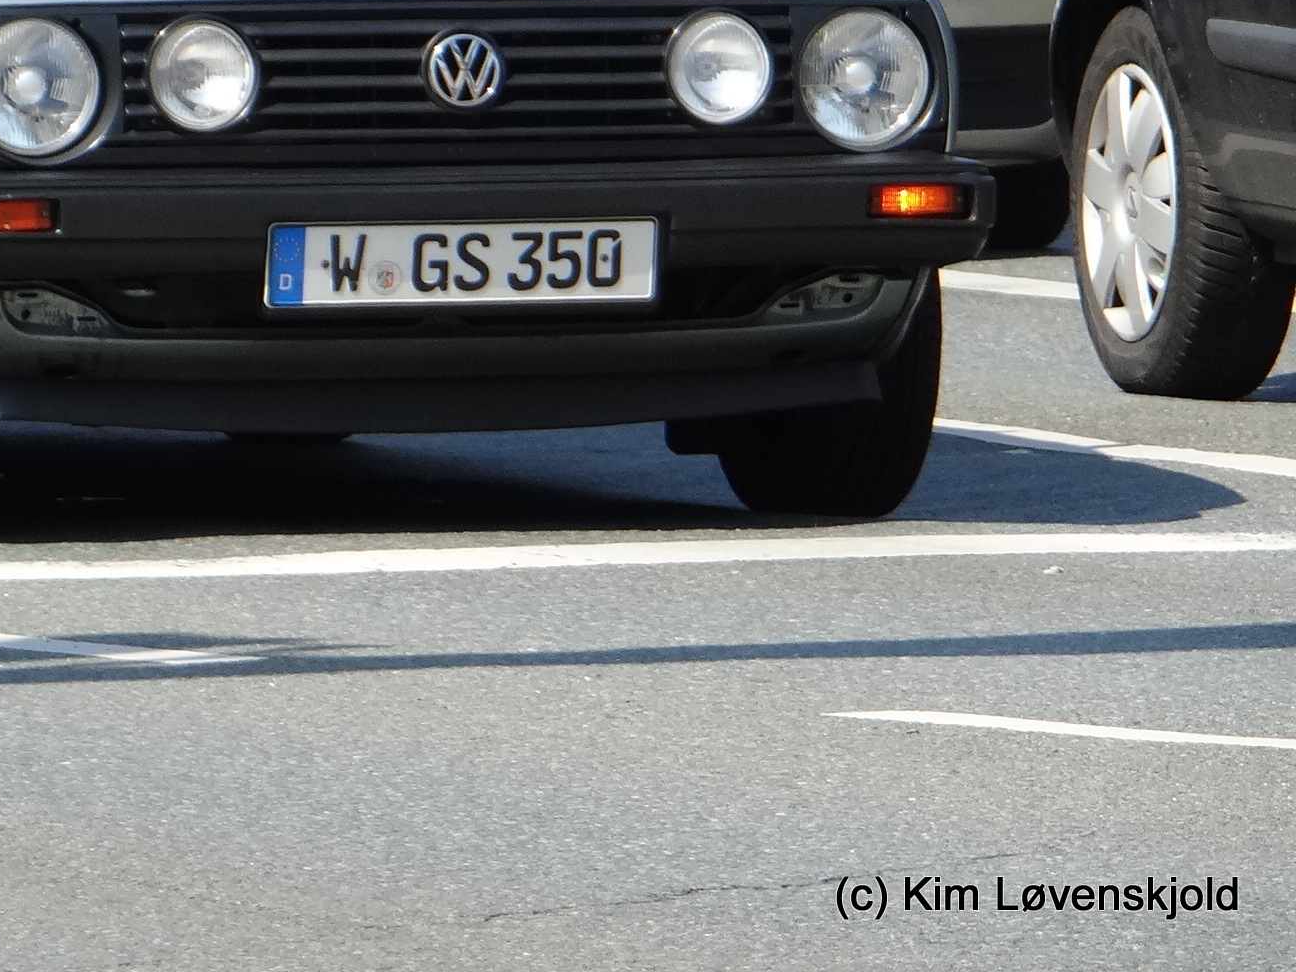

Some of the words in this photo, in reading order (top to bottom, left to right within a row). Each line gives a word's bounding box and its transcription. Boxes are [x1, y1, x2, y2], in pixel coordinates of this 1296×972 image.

[430, 34, 500, 106] VW
[279, 273, 292, 290] D
[330, 233, 367, 292] W
[412, 232, 492, 292] GS
[507, 229, 622, 291] 350
